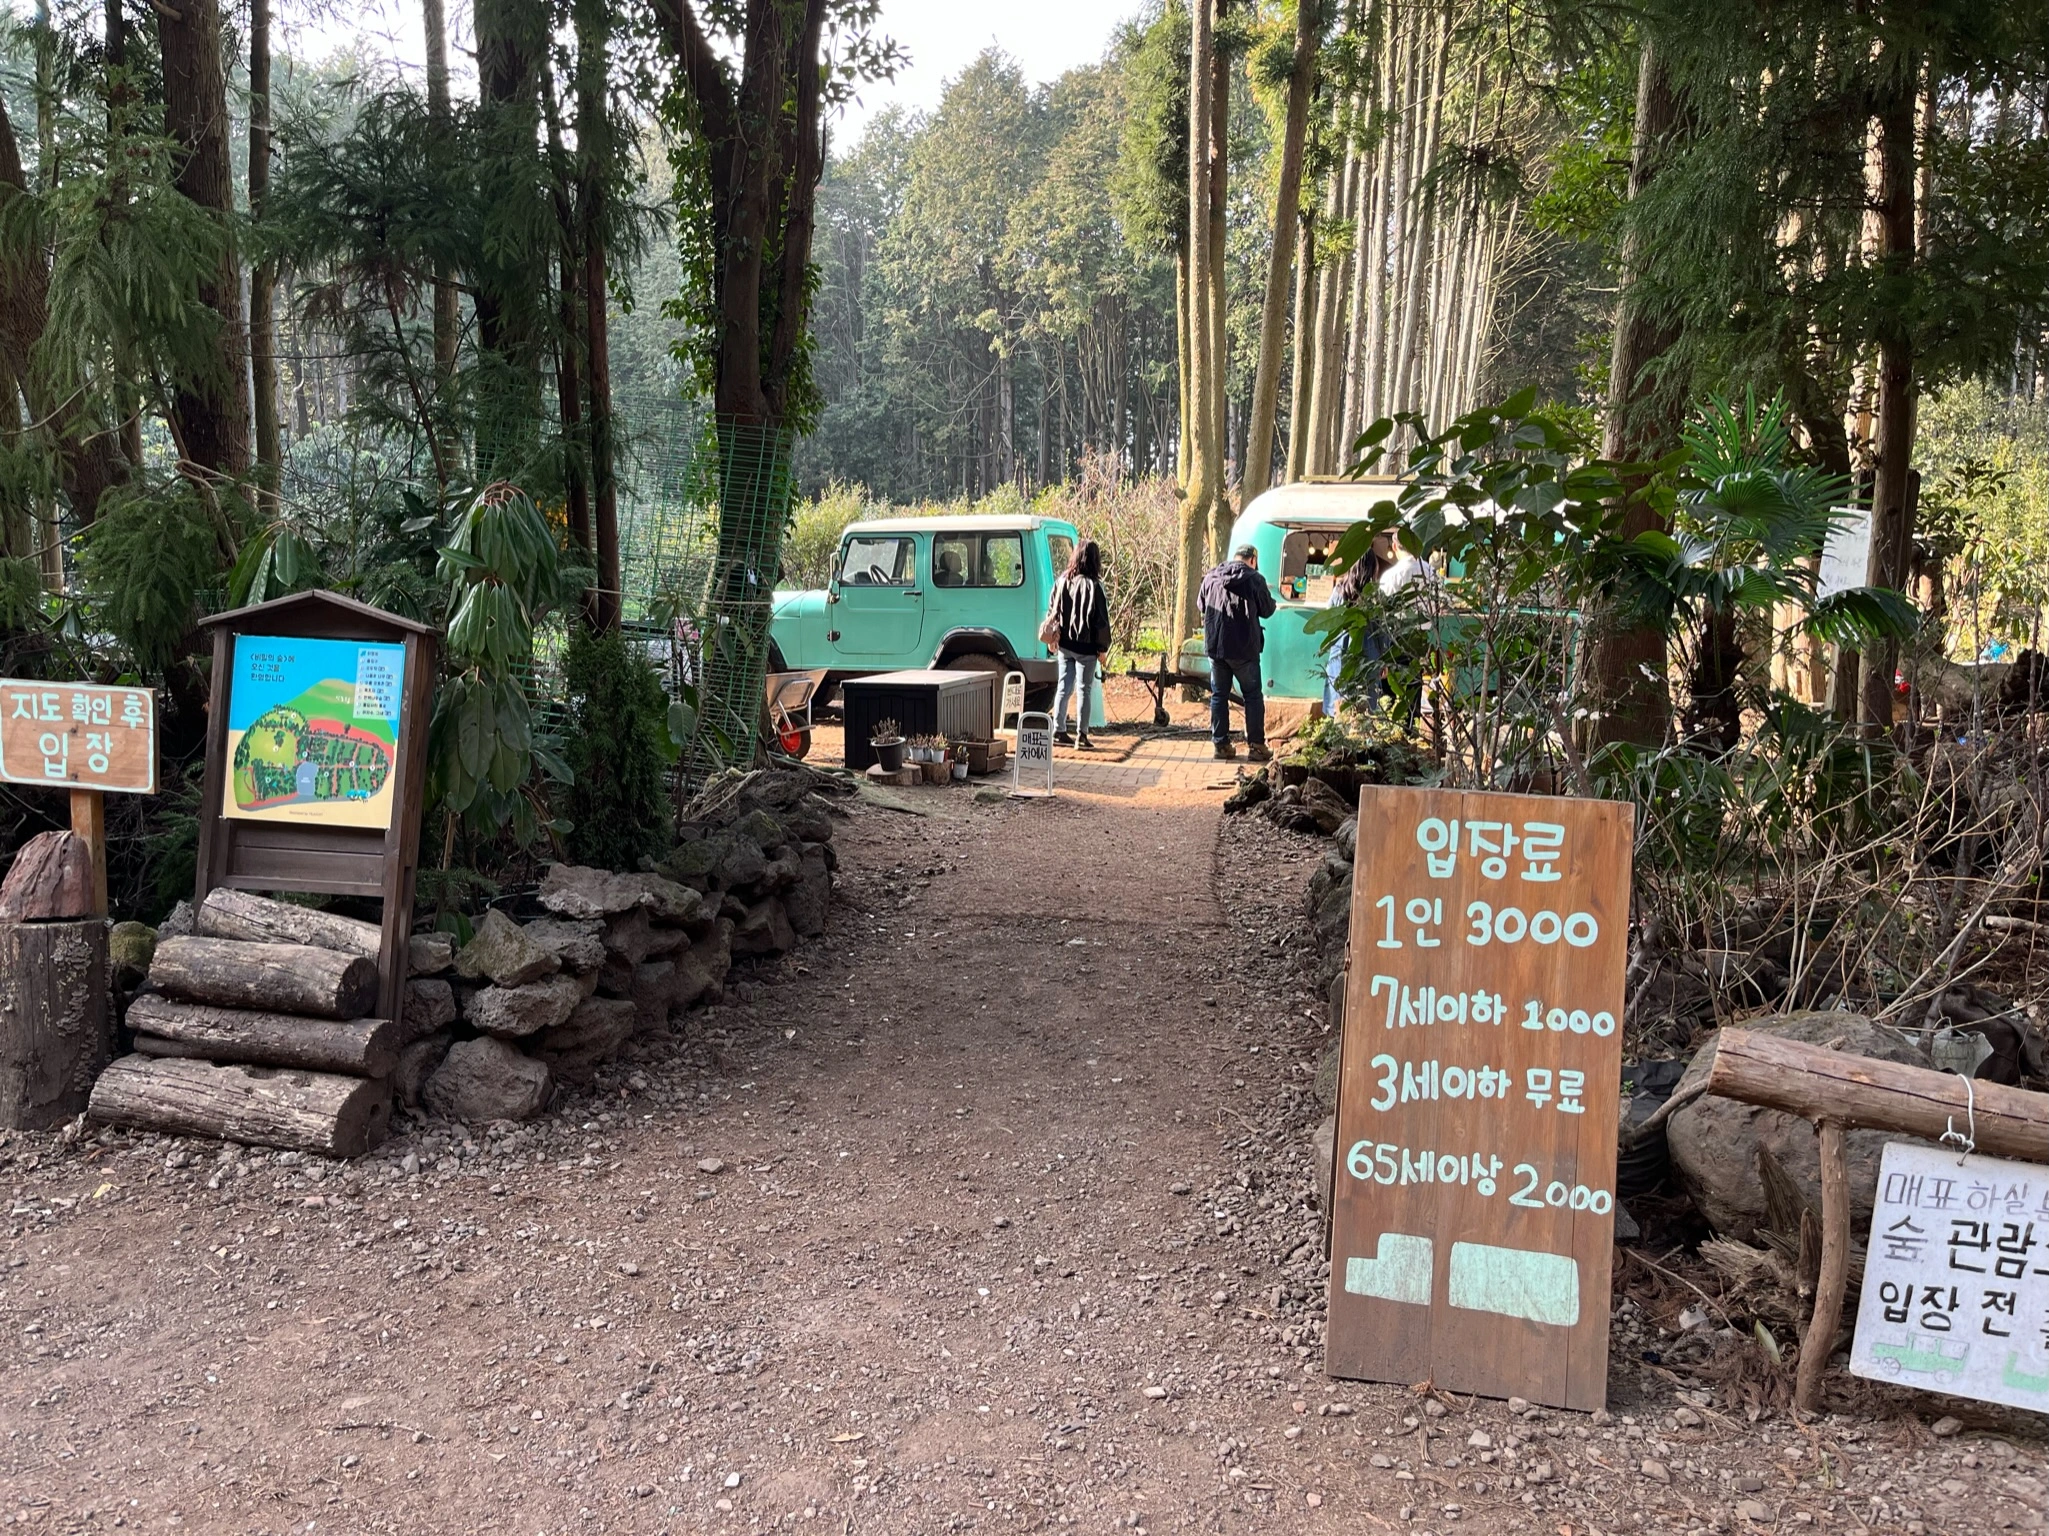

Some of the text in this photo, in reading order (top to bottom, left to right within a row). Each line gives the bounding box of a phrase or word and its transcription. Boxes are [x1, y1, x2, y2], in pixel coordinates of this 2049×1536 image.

[251, 673, 285, 682] 환영합니다
[11, 692, 145, 729] 지도 확인 후
[1020, 747, 1048, 760] 차에서
[1022, 732, 1049, 746] 매표는
[1416, 817, 1565, 882] 입장료
[1375, 895, 1599, 949] 1인 3000
[1370, 974, 1616, 1037] 7세이하 1000
[1370, 1053, 1586, 1114] 3세이하 무료
[1346, 1140, 1613, 1215] 65세이상 2000
[1881, 1214, 1929, 1263] 숲
[1879, 1281, 1960, 1332] 입장
[1980, 1290, 2018, 1338] 전
